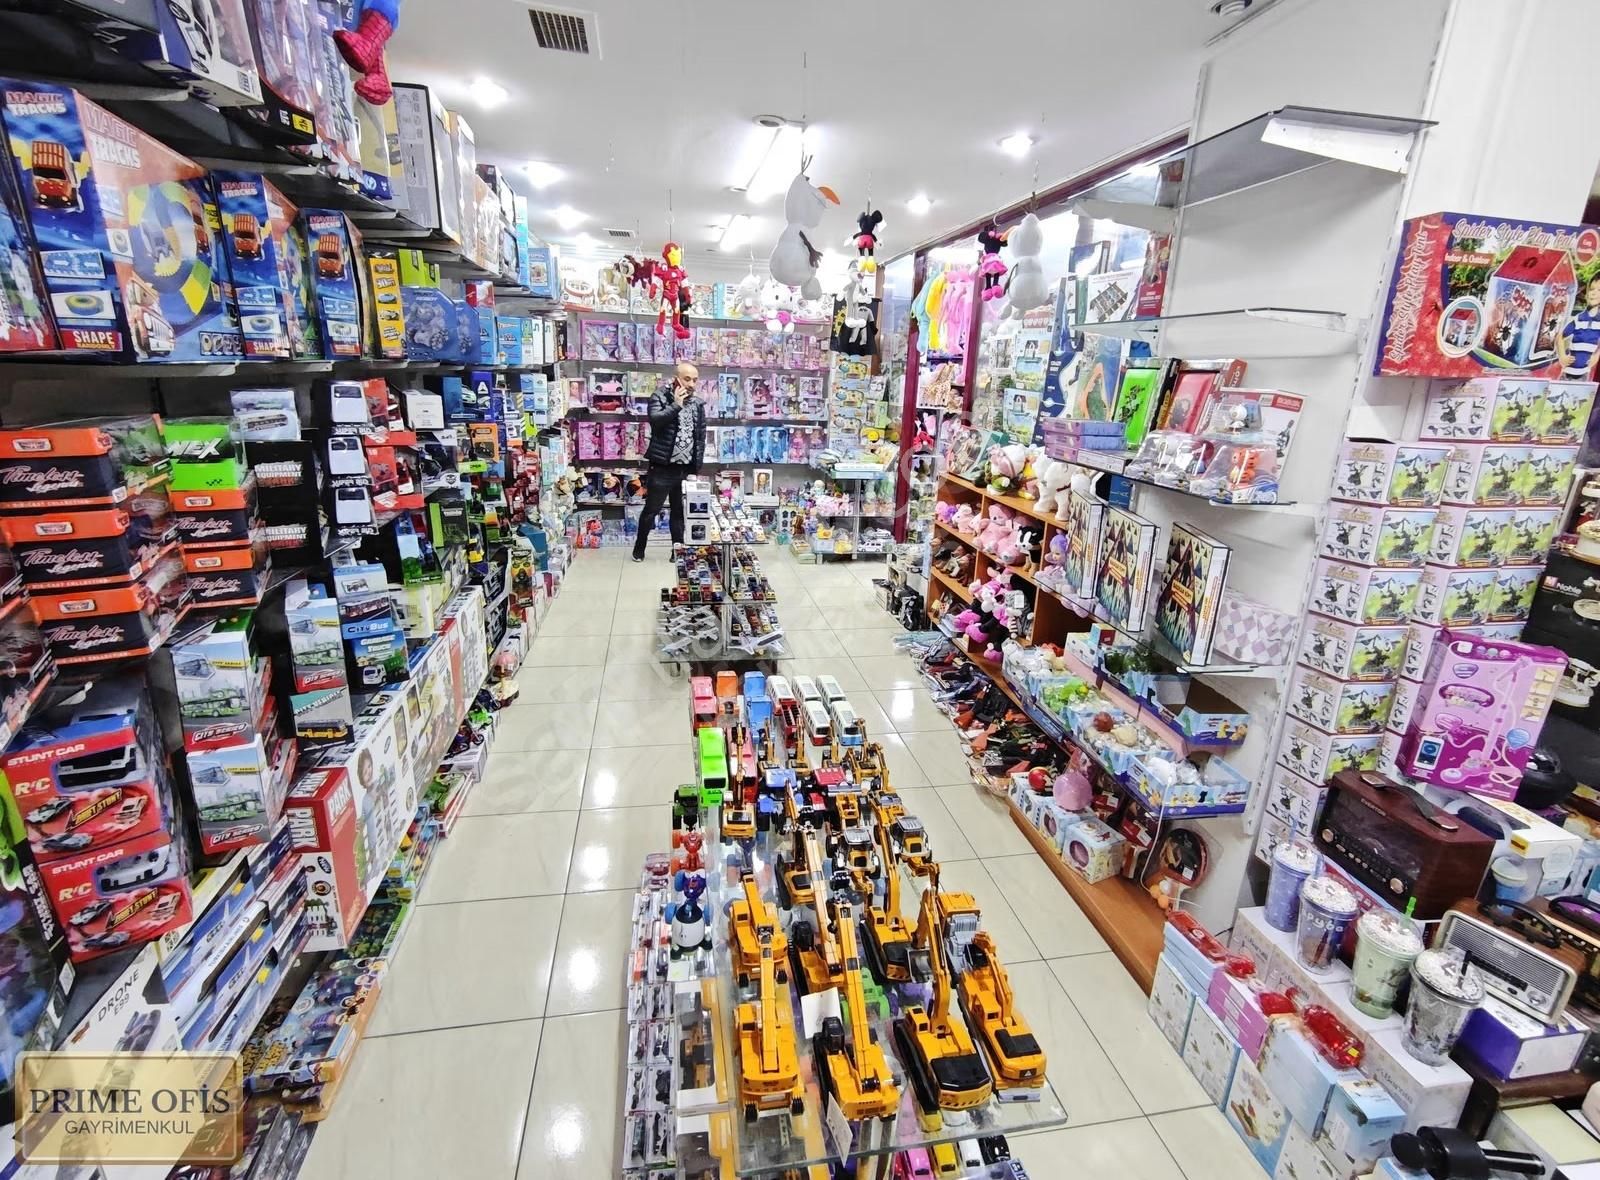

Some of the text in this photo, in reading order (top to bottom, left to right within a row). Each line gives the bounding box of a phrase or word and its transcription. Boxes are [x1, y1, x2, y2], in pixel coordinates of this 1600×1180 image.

[7, 103, 67, 116] TRACKS
[88, 132, 142, 168] TRACKS
[222, 189, 258, 198] TRACKS
[310, 221, 342, 230] TRACKS
[1452, 218, 1494, 243] Spider
[1496, 222, 1525, 247] Style
[1526, 226, 1554, 247] Play
[74, 331, 114, 345] SHAPE
[254, 461, 302, 472] MILITARY
[256, 471, 302, 479] EQUIPMENT
[1556, 582, 1583, 596] Noble
[193, 730, 215, 743] CITY
[7, 743, 86, 768] STUNT CAR
[286, 807, 320, 848] PARK
[52, 848, 125, 875] STUNT CAR
[98, 967, 141, 1022] DRONE
[112, 991, 132, 1016] E99
